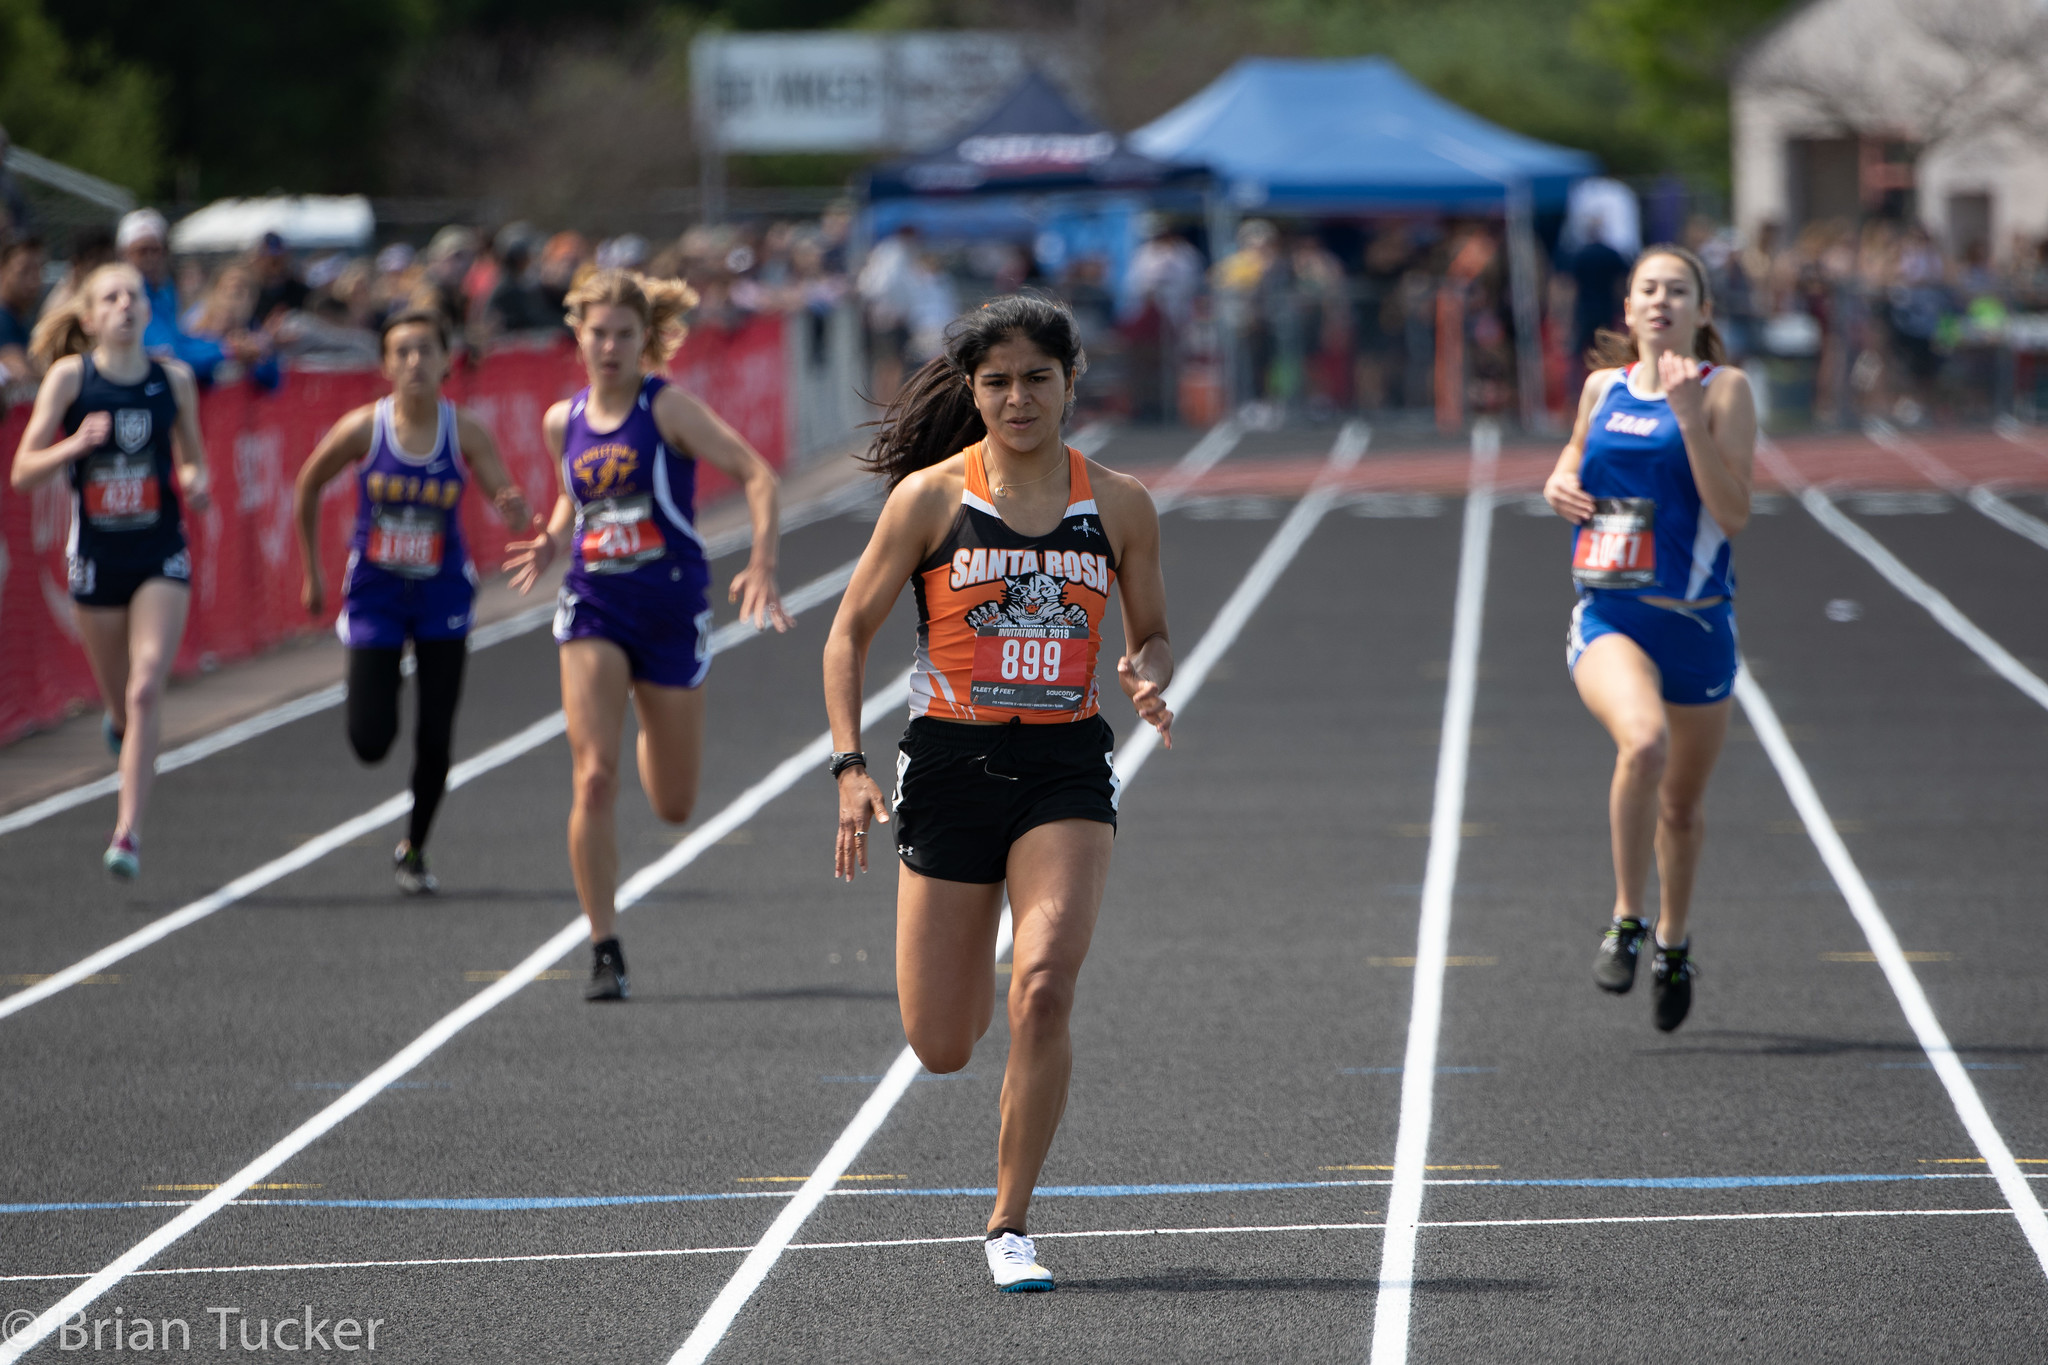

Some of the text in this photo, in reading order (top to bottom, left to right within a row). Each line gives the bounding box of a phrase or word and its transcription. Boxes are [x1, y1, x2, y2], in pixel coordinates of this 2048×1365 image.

[1605, 411, 1660, 437] TAM
[1585, 532, 1641, 569] 1047
[950, 547, 1108, 597] SANTA ROSA
[998, 627, 1070, 639] INVITATIONAL 2019
[1001, 639, 1061, 682] 899
[972, 685, 1016, 696] FLEET FEET
[1046, 689, 1075, 698] saucony
